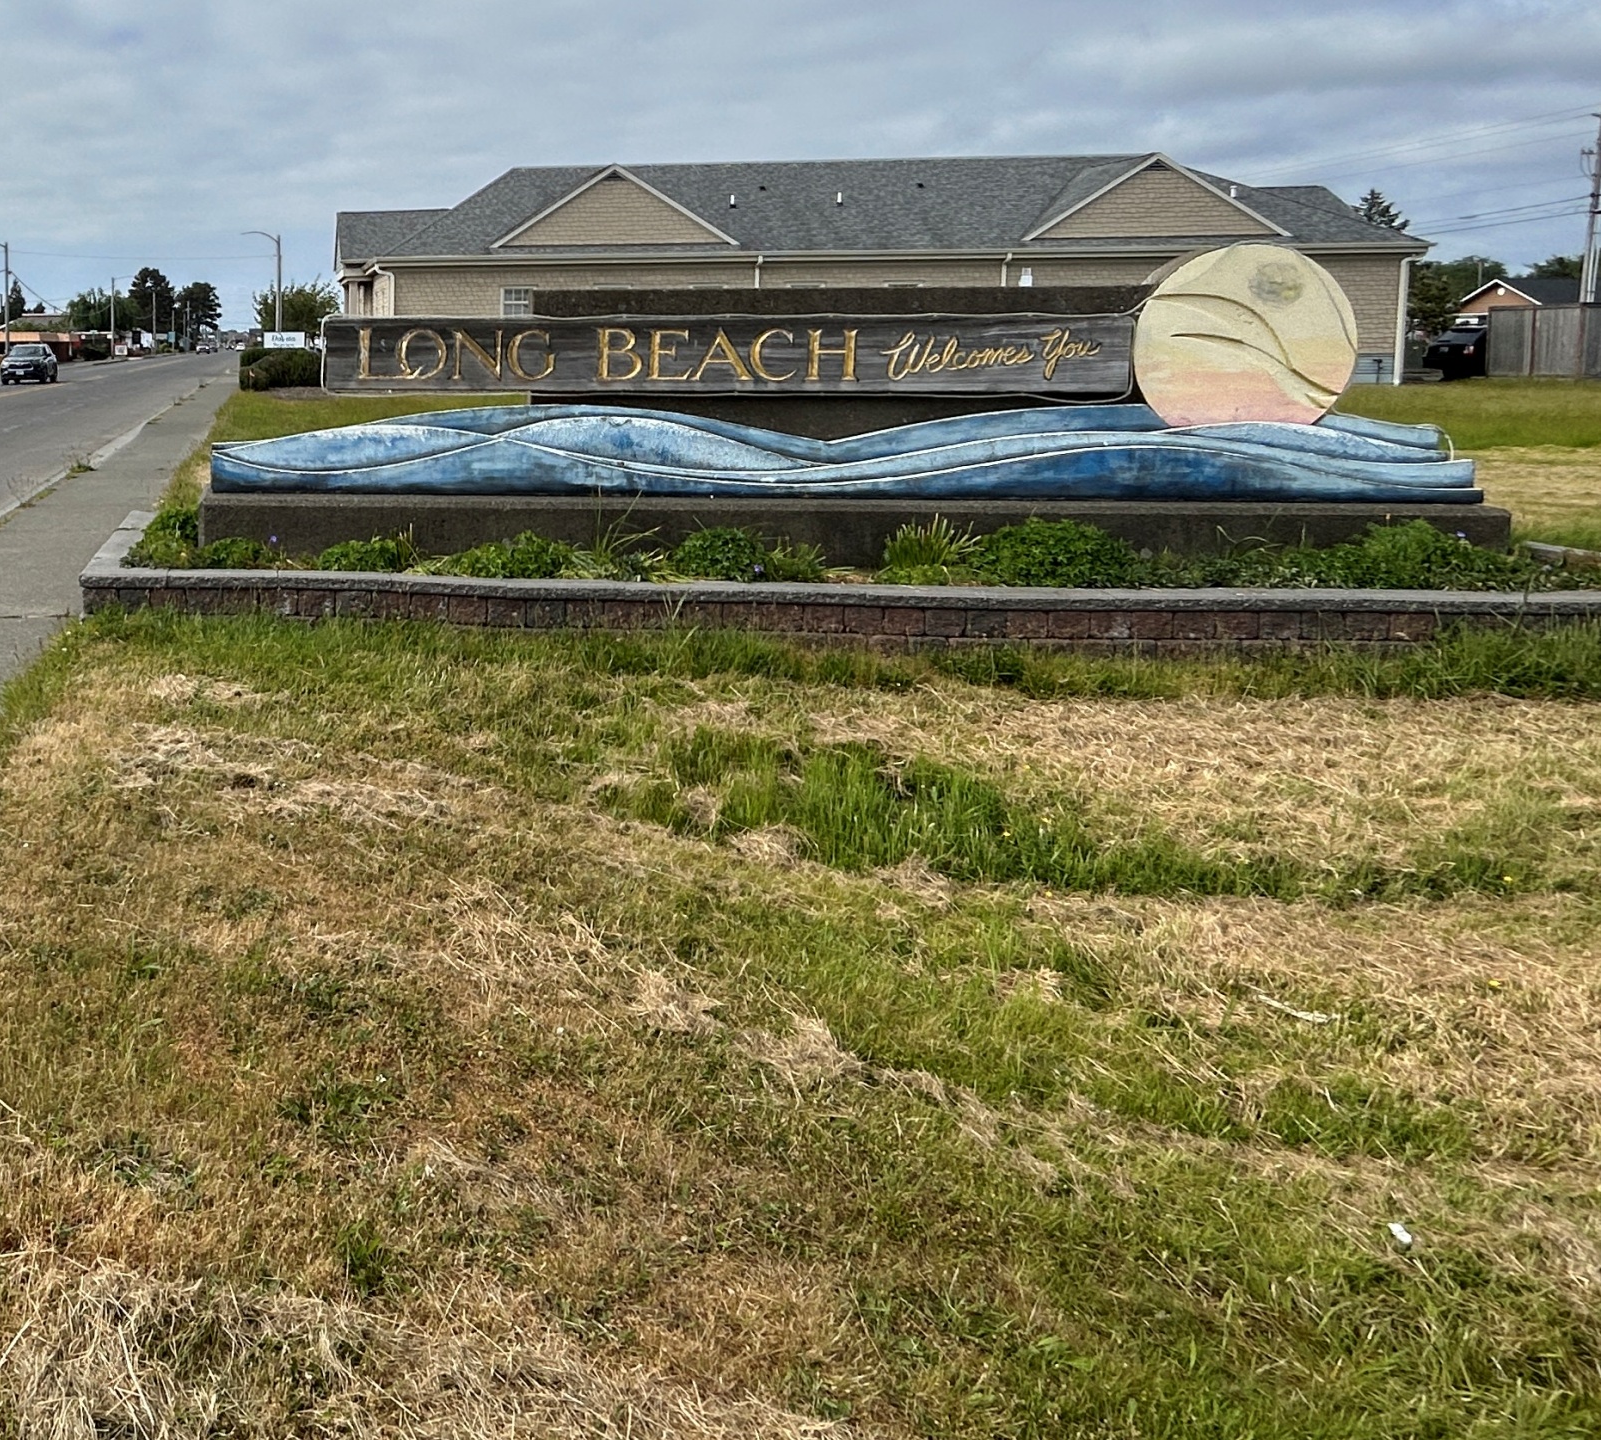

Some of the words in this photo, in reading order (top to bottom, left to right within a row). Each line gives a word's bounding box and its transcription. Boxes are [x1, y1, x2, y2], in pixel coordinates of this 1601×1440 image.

[357, 327, 556, 382] LONG
[596, 326, 859, 382] BEACH
[880, 330, 1035, 381] Welcomes
[1040, 328, 1102, 380] You
